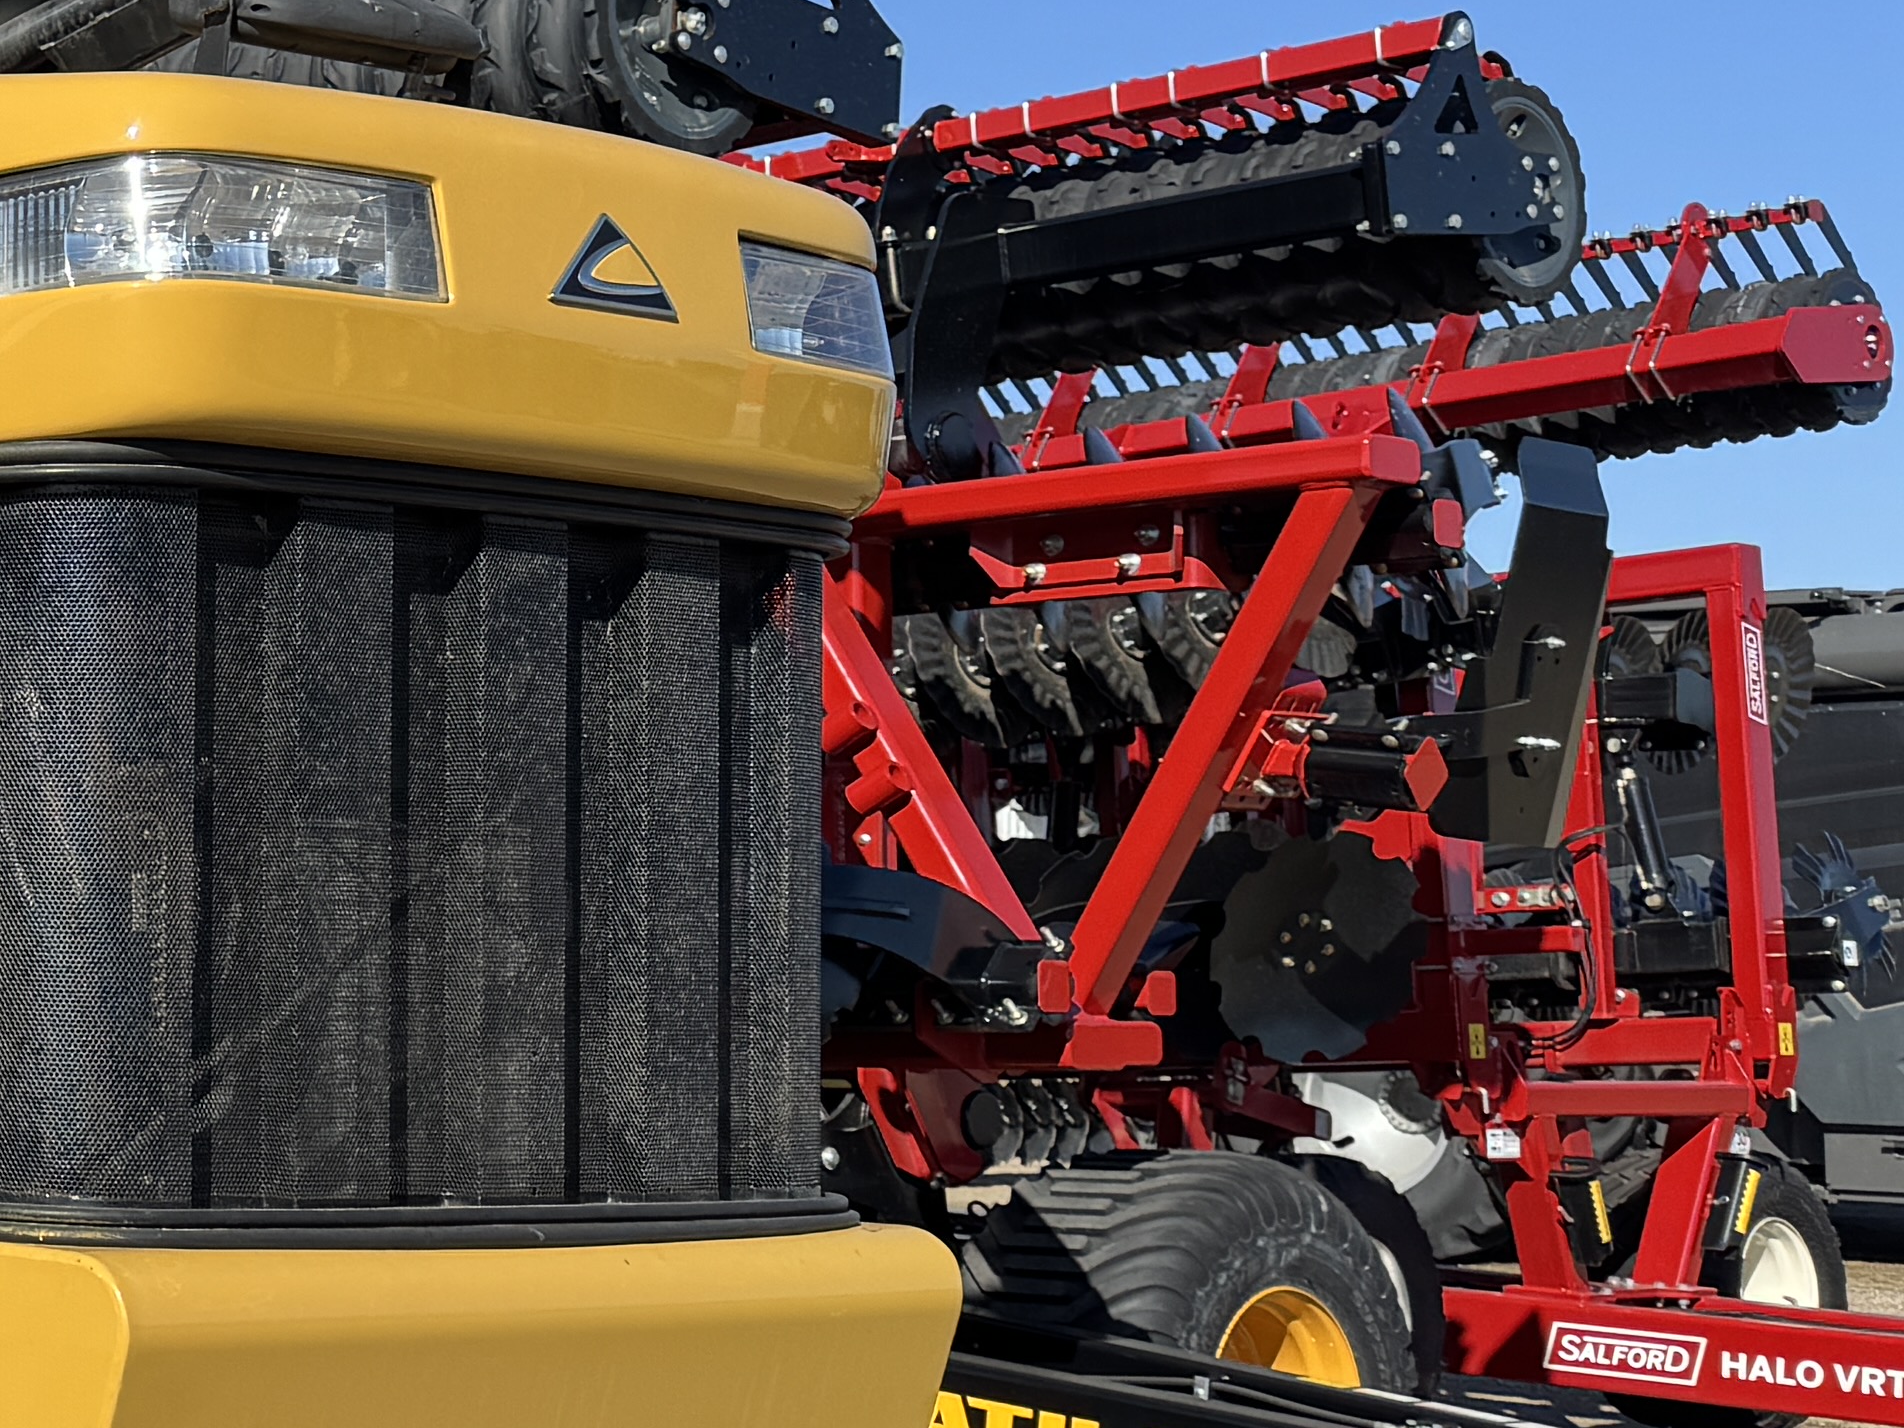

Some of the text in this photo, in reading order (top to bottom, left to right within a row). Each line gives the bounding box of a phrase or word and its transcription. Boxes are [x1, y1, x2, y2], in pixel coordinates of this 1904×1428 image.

[1745, 632, 1762, 715] SALFORD
[1557, 1333, 1690, 1374] SALFORD
[1721, 1350, 1904, 1399] HALO VRT
